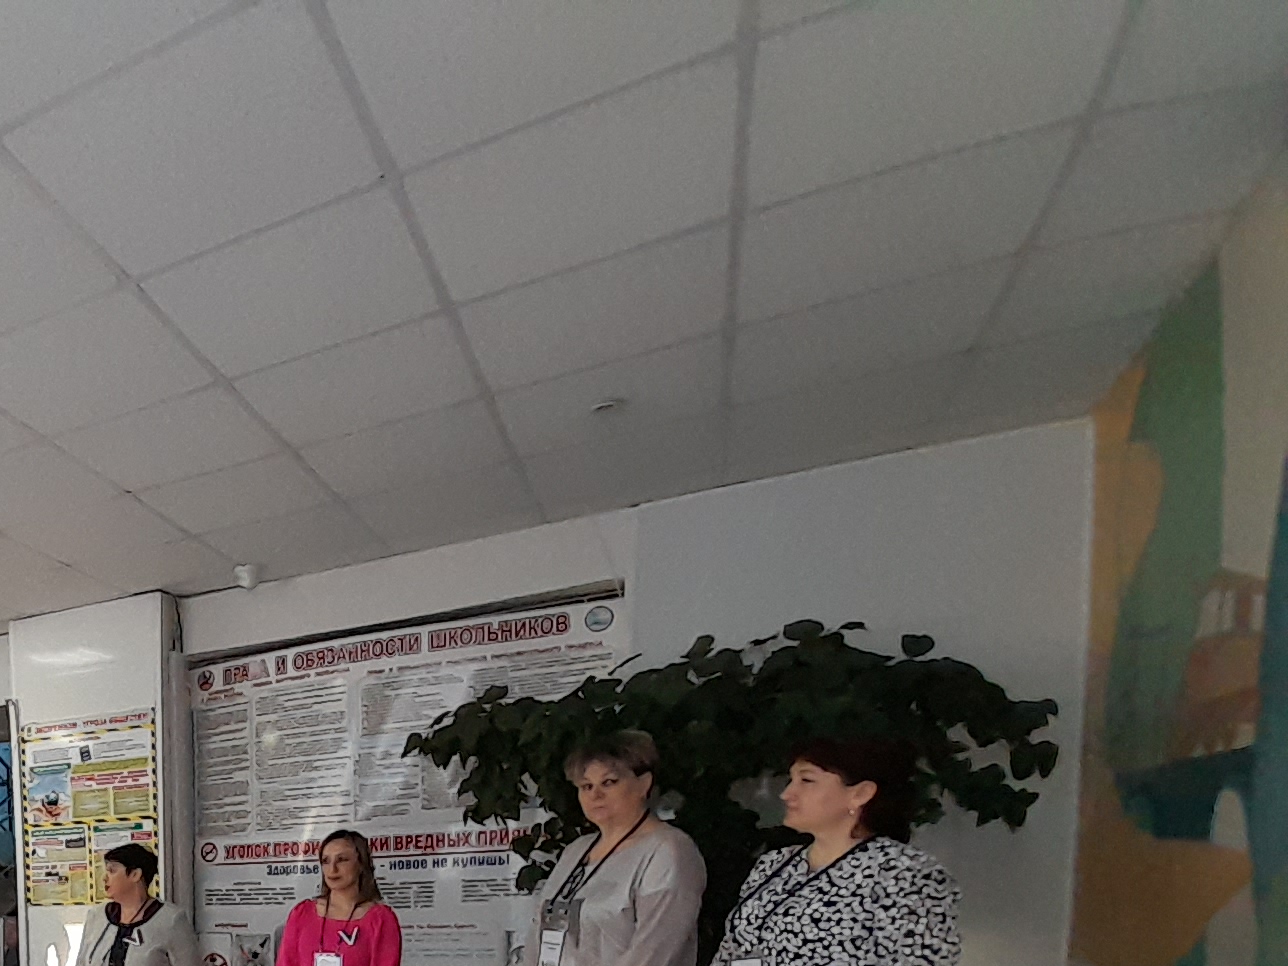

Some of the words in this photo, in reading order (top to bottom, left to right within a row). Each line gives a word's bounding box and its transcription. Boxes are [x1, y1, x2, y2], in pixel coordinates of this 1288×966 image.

[275, 656, 288, 675] И
[292, 633, 421, 671] ОБЯЗАННОСТИ
[428, 613, 570, 651] ШКОЛЬНИКОВ
[394, 831, 473, 852] ВРЕДНЫХ
[389, 859, 427, 870] новое
[432, 858, 448, 868] не
